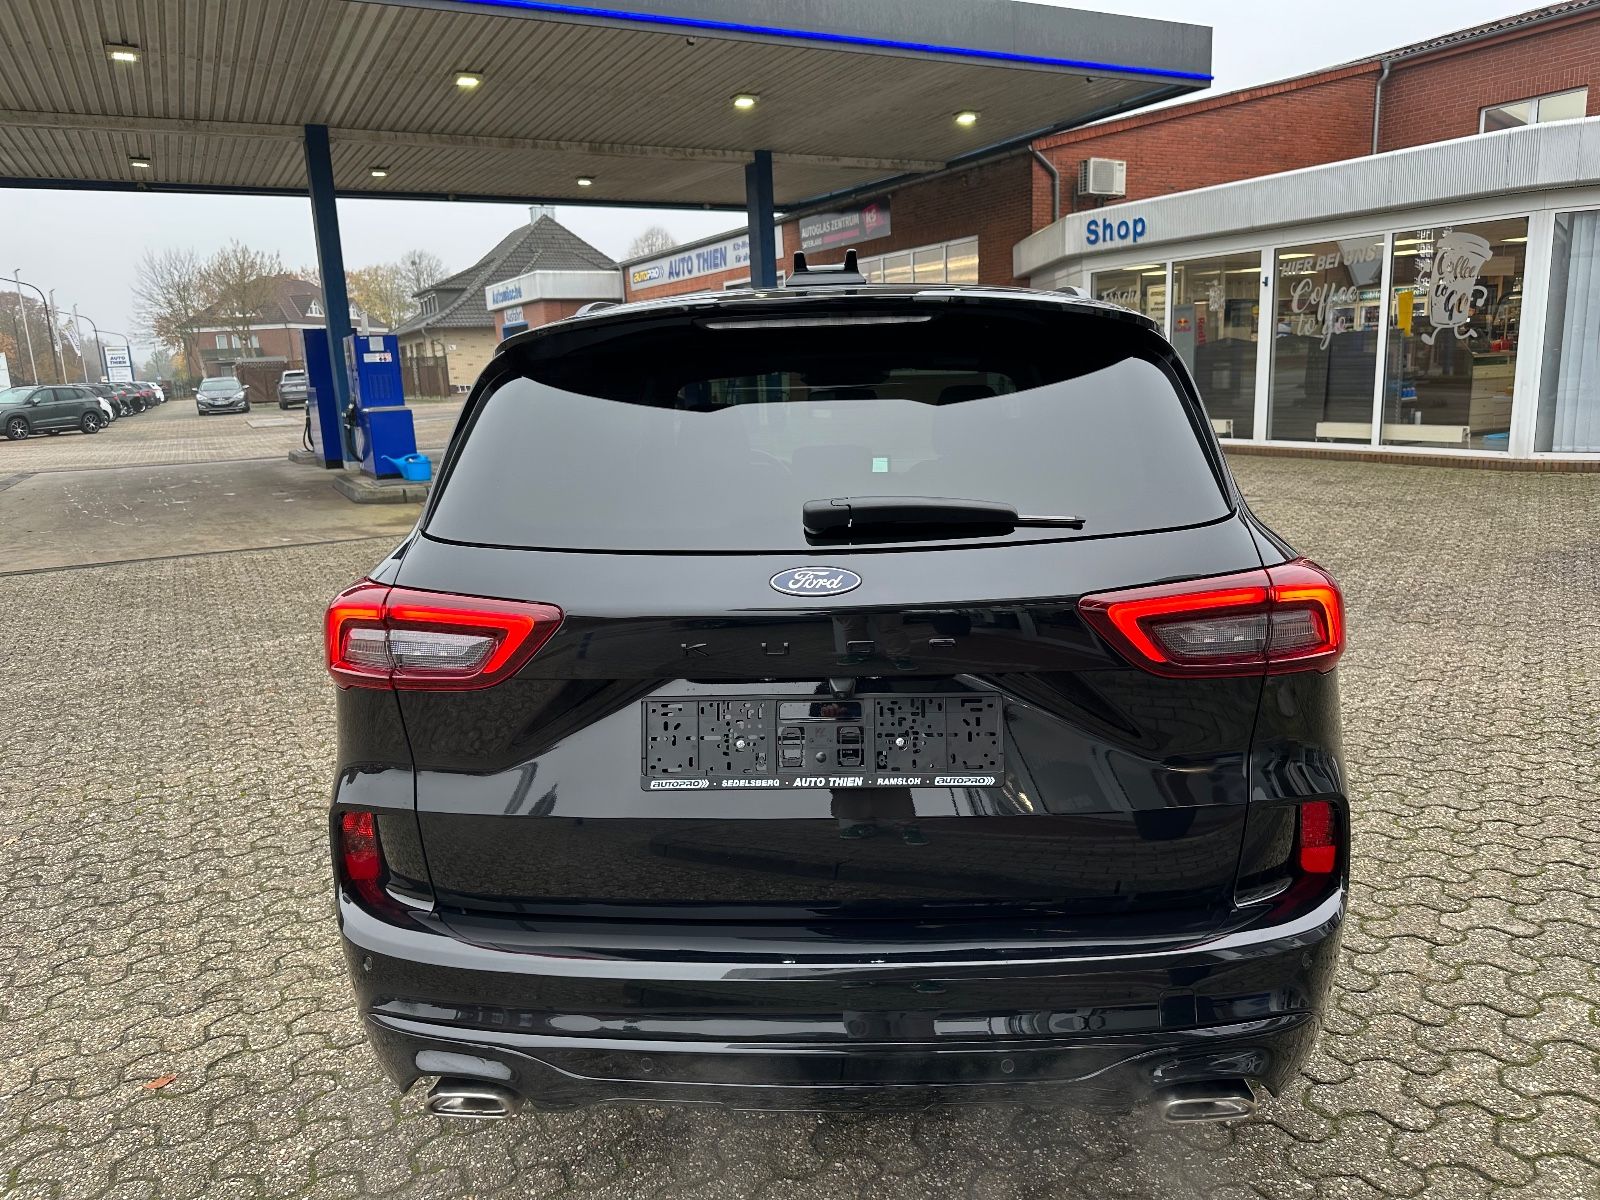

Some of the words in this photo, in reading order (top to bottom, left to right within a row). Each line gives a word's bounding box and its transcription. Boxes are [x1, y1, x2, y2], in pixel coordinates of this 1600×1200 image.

[801, 221, 831, 239] AUTOGLAS
[831, 212, 860, 231] ZENTRUM
[1086, 217, 1146, 245] Shop
[668, 257, 693, 280] AUTO
[695, 246, 727, 273] THIEN
[1281, 258, 1313, 277] HIER
[1315, 253, 1340, 271] BEI
[1343, 245, 1377, 266] UNS
[1436, 250, 1477, 280] Coffee
[1290, 278, 1356, 322] Coffee
[1296, 313, 1316, 336] to
[1319, 316, 1346, 351] go
[788, 570, 843, 589] Ford
[721, 779, 780, 787] SEDELSBERG
[793, 777, 826, 787] AUTO
[828, 777, 864, 787] THIEN
[876, 778, 921, 786] RAMSLOH
